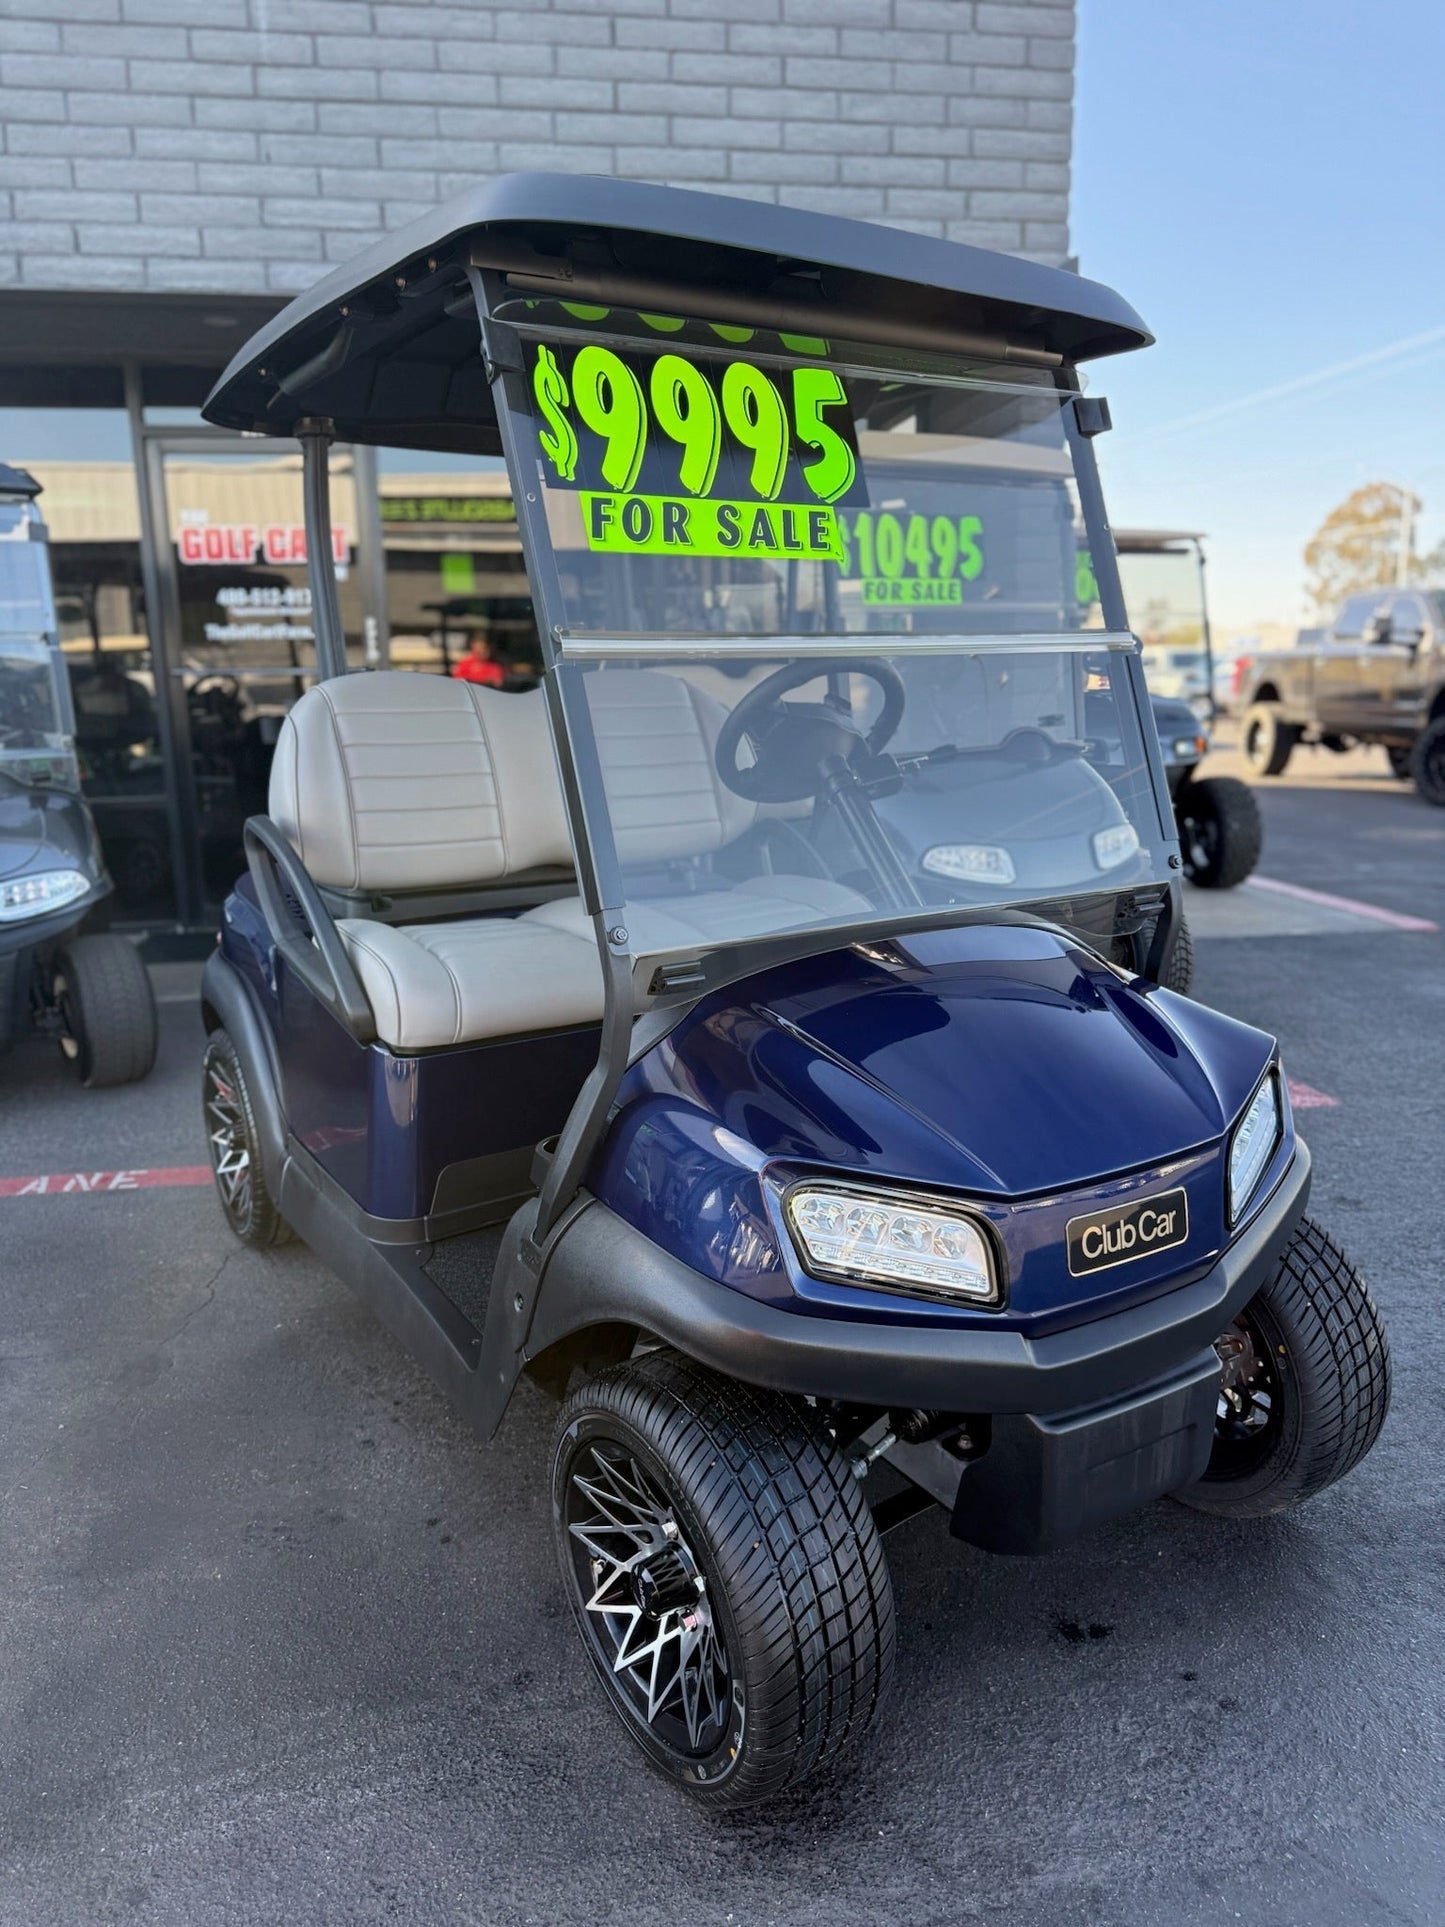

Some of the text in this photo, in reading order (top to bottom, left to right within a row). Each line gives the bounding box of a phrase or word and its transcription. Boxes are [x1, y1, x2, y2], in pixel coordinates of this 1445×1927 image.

[533, 344, 856, 504] $9995
[180, 526, 349, 564] GOLF CAT
[590, 497, 832, 552] FOR SALE
[865, 581, 961, 601] FOR SALE
[1081, 1209, 1177, 1259] Club Car
